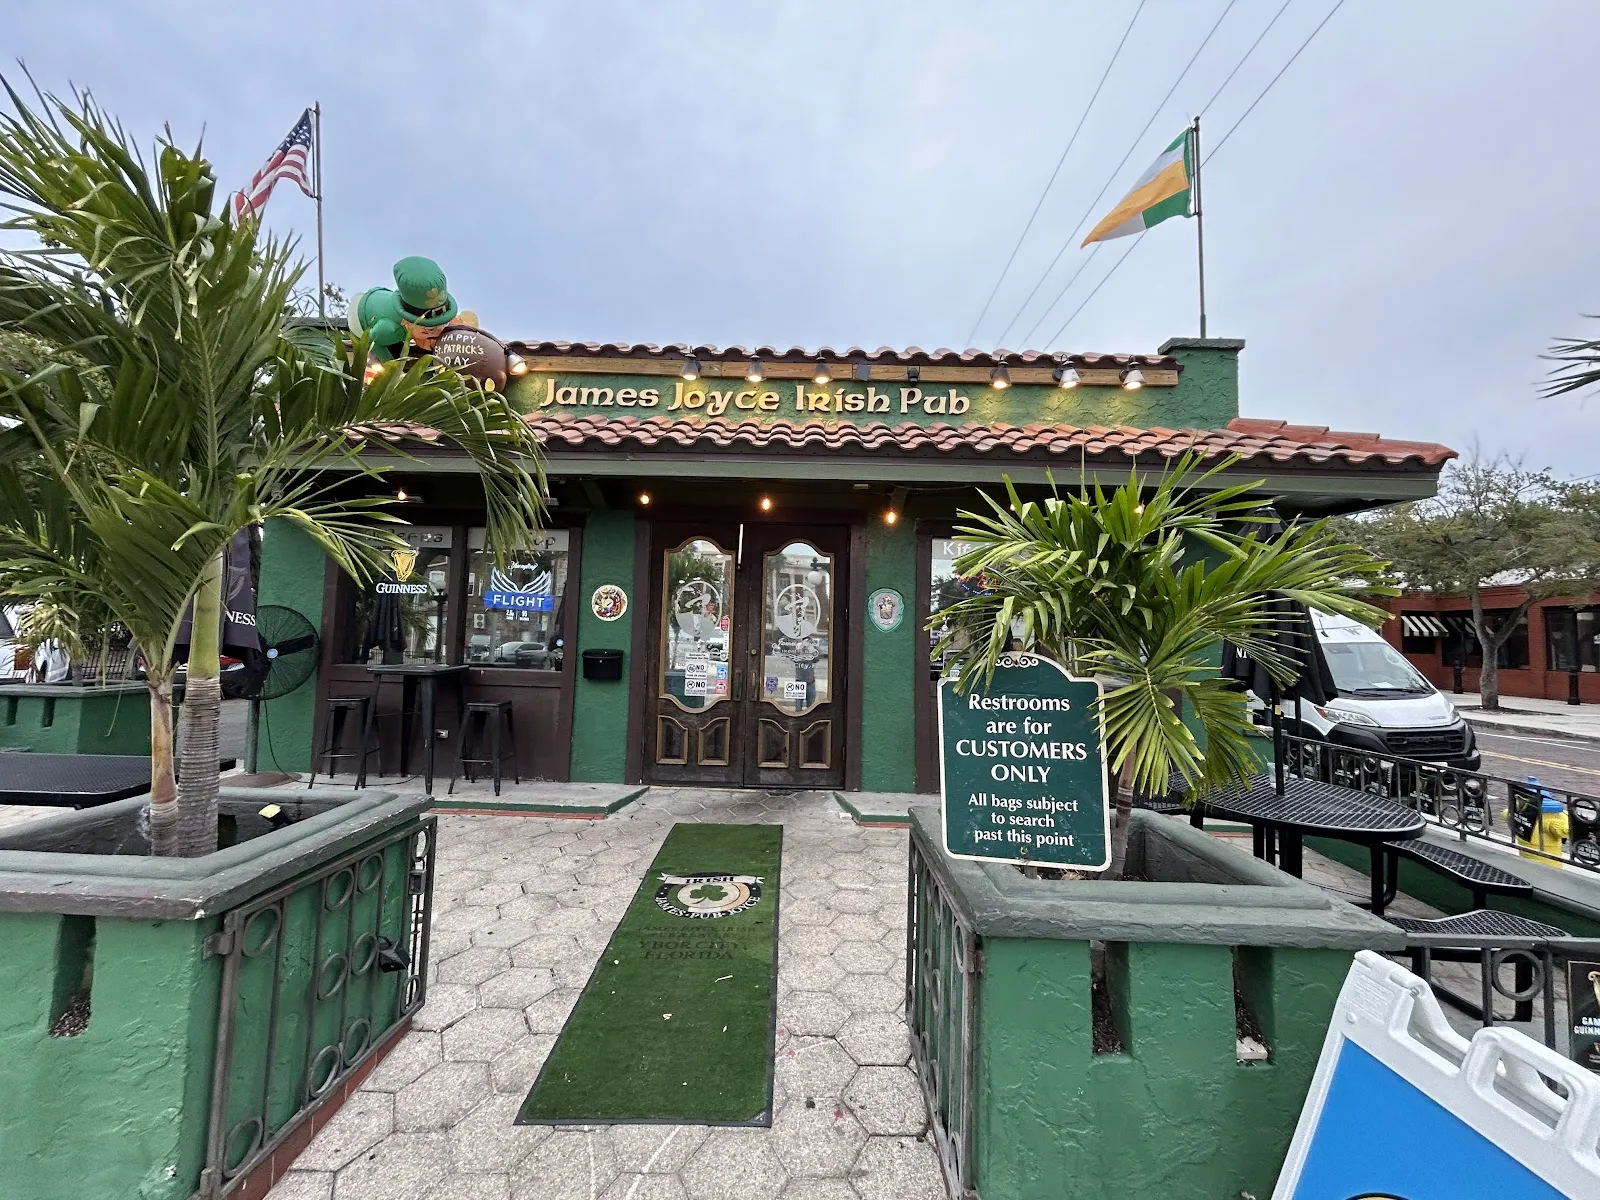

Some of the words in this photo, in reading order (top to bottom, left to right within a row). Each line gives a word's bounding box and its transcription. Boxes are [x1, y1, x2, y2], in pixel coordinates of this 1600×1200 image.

[441, 334, 476, 343] HAPPY
[444, 356, 470, 366] DAY
[540, 379, 659, 407] James
[667, 383, 780, 416] Joyce
[900, 388, 970, 414] Pub
[493, 594, 545, 608] FLIGHT
[969, 693, 1070, 711] Restrooms
[986, 720, 1017, 735] are
[1023, 716, 1052, 735] for
[956, 739, 1087, 761] CUSTOMERS
[991, 764, 1051, 783] ONLY
[968, 793, 987, 806] All
[991, 794, 1023, 811] bags
[1026, 797, 1078, 814] subject
[991, 812, 1005, 824] to
[1009, 814, 1055, 828] search
[974, 829, 1002, 843] past
[1007, 829, 1032, 843] this
[1036, 833, 1074, 848] point
[728, 896, 760, 916] JOYCE
[643, 951, 733, 960] FLORIDA
